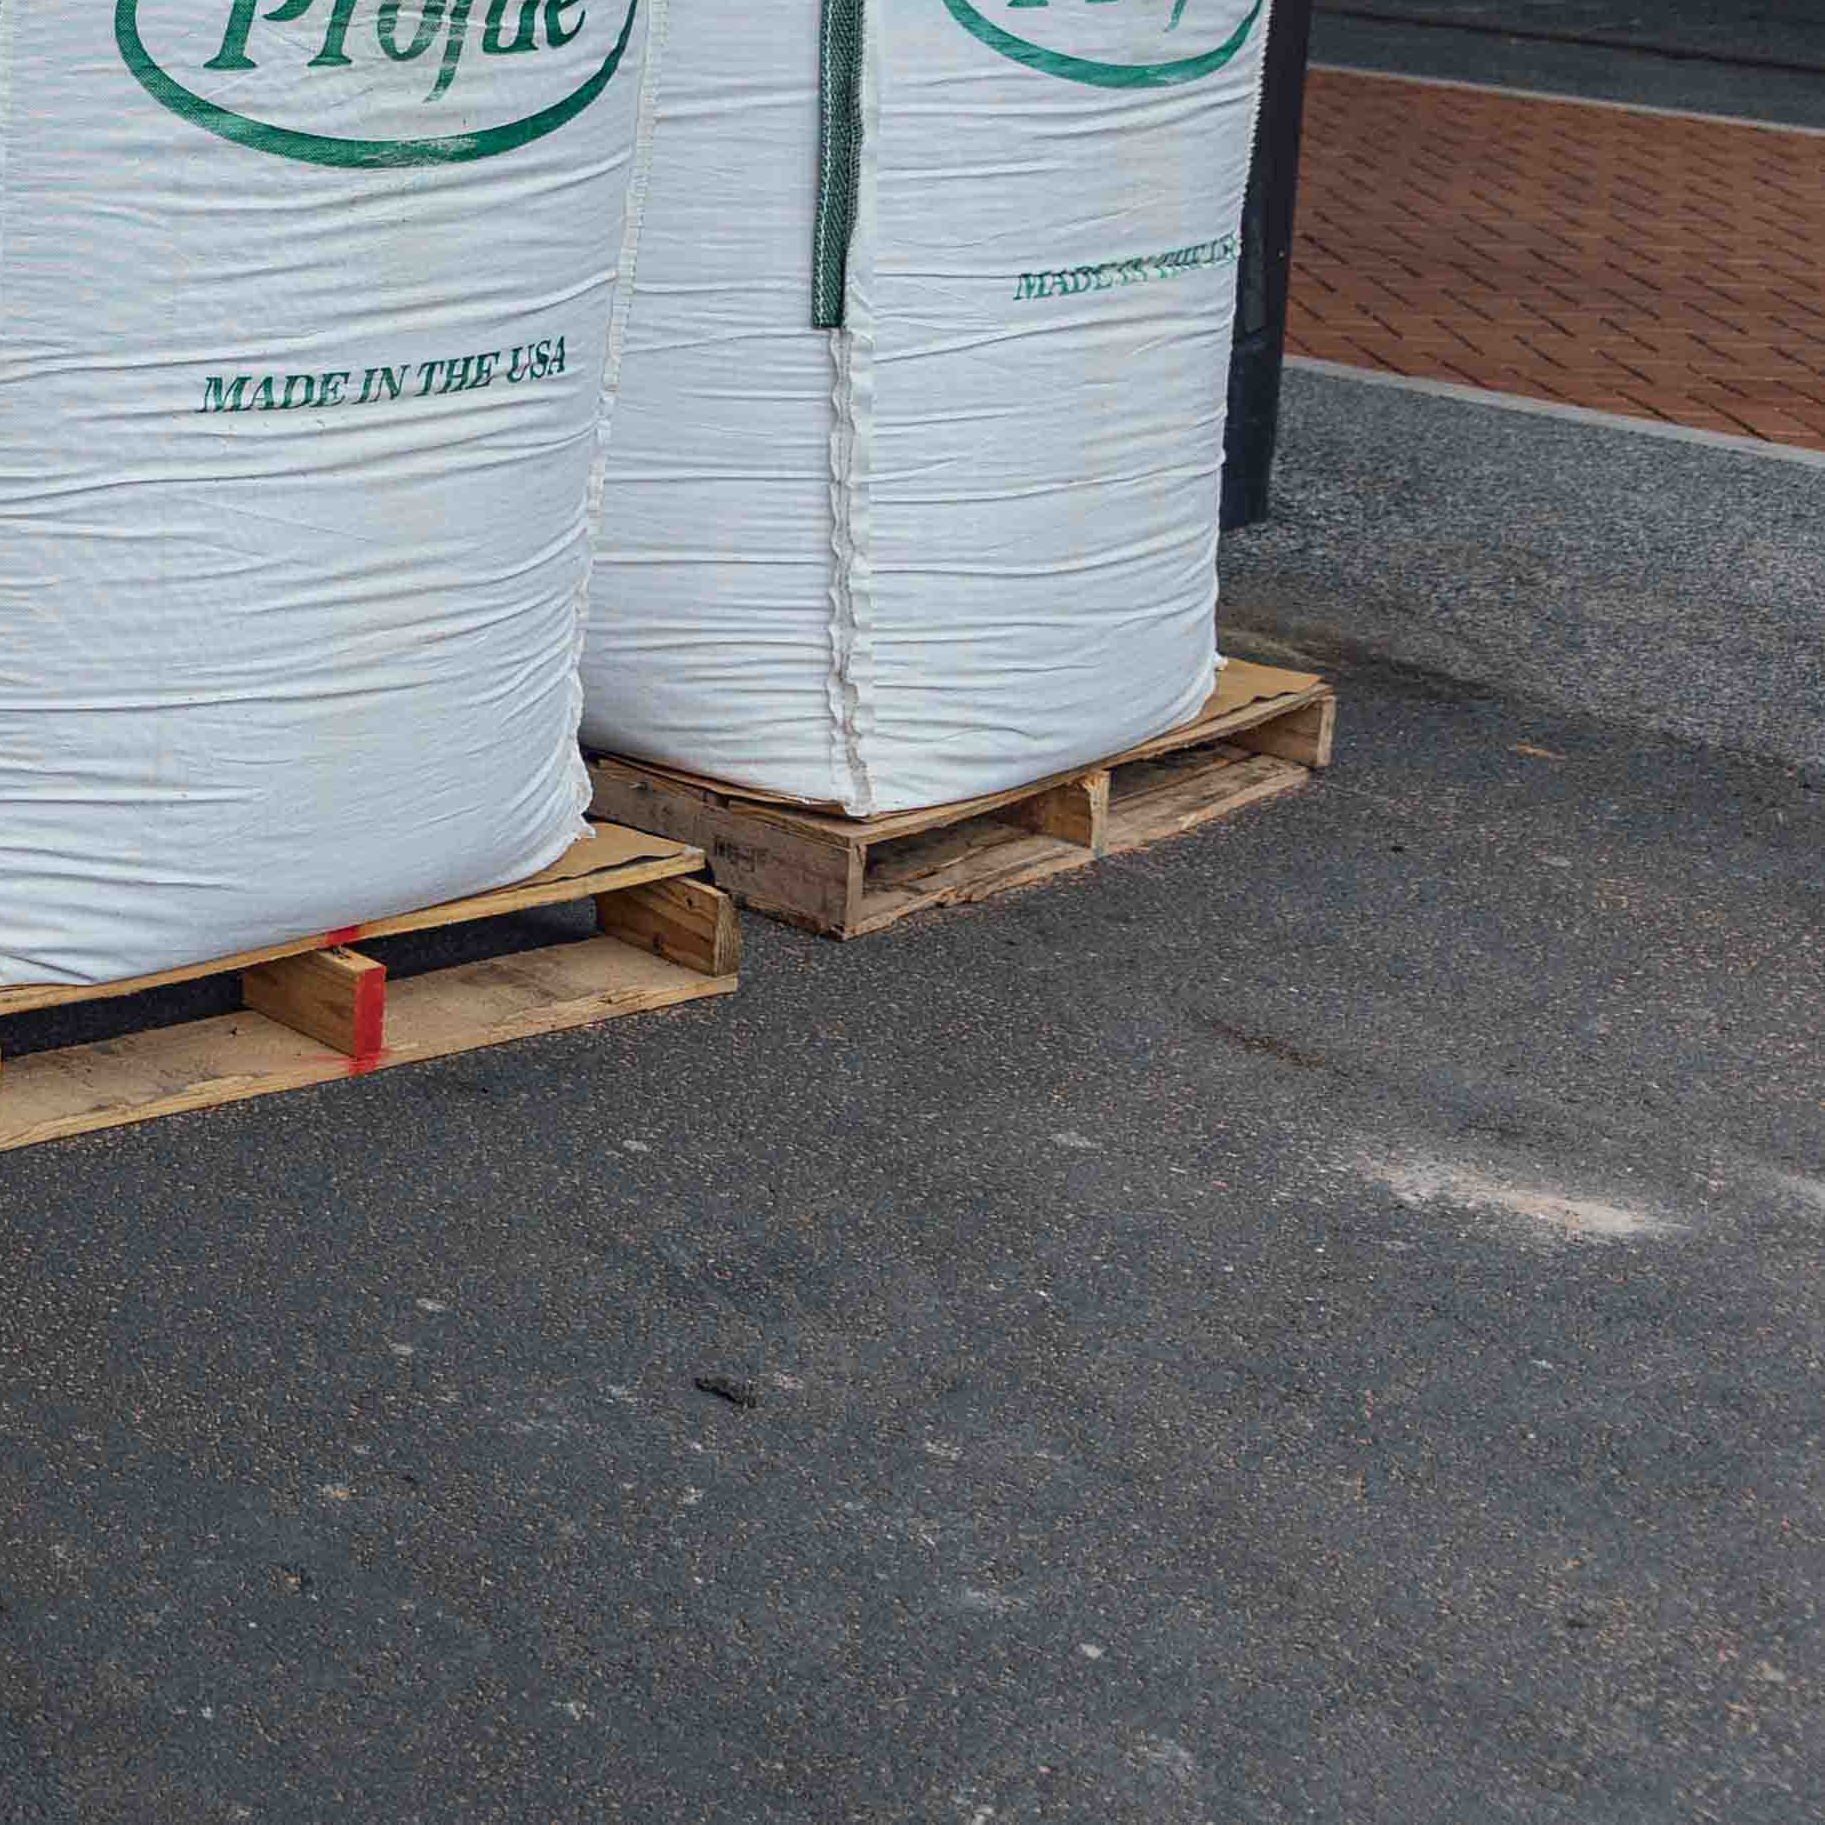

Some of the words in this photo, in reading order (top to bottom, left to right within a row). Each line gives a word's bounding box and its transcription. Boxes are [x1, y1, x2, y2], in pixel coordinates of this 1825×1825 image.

[195, 372, 349, 413] MADE
[352, 364, 410, 405] IN
[413, 351, 500, 397] THE
[508, 335, 566, 383] USA
